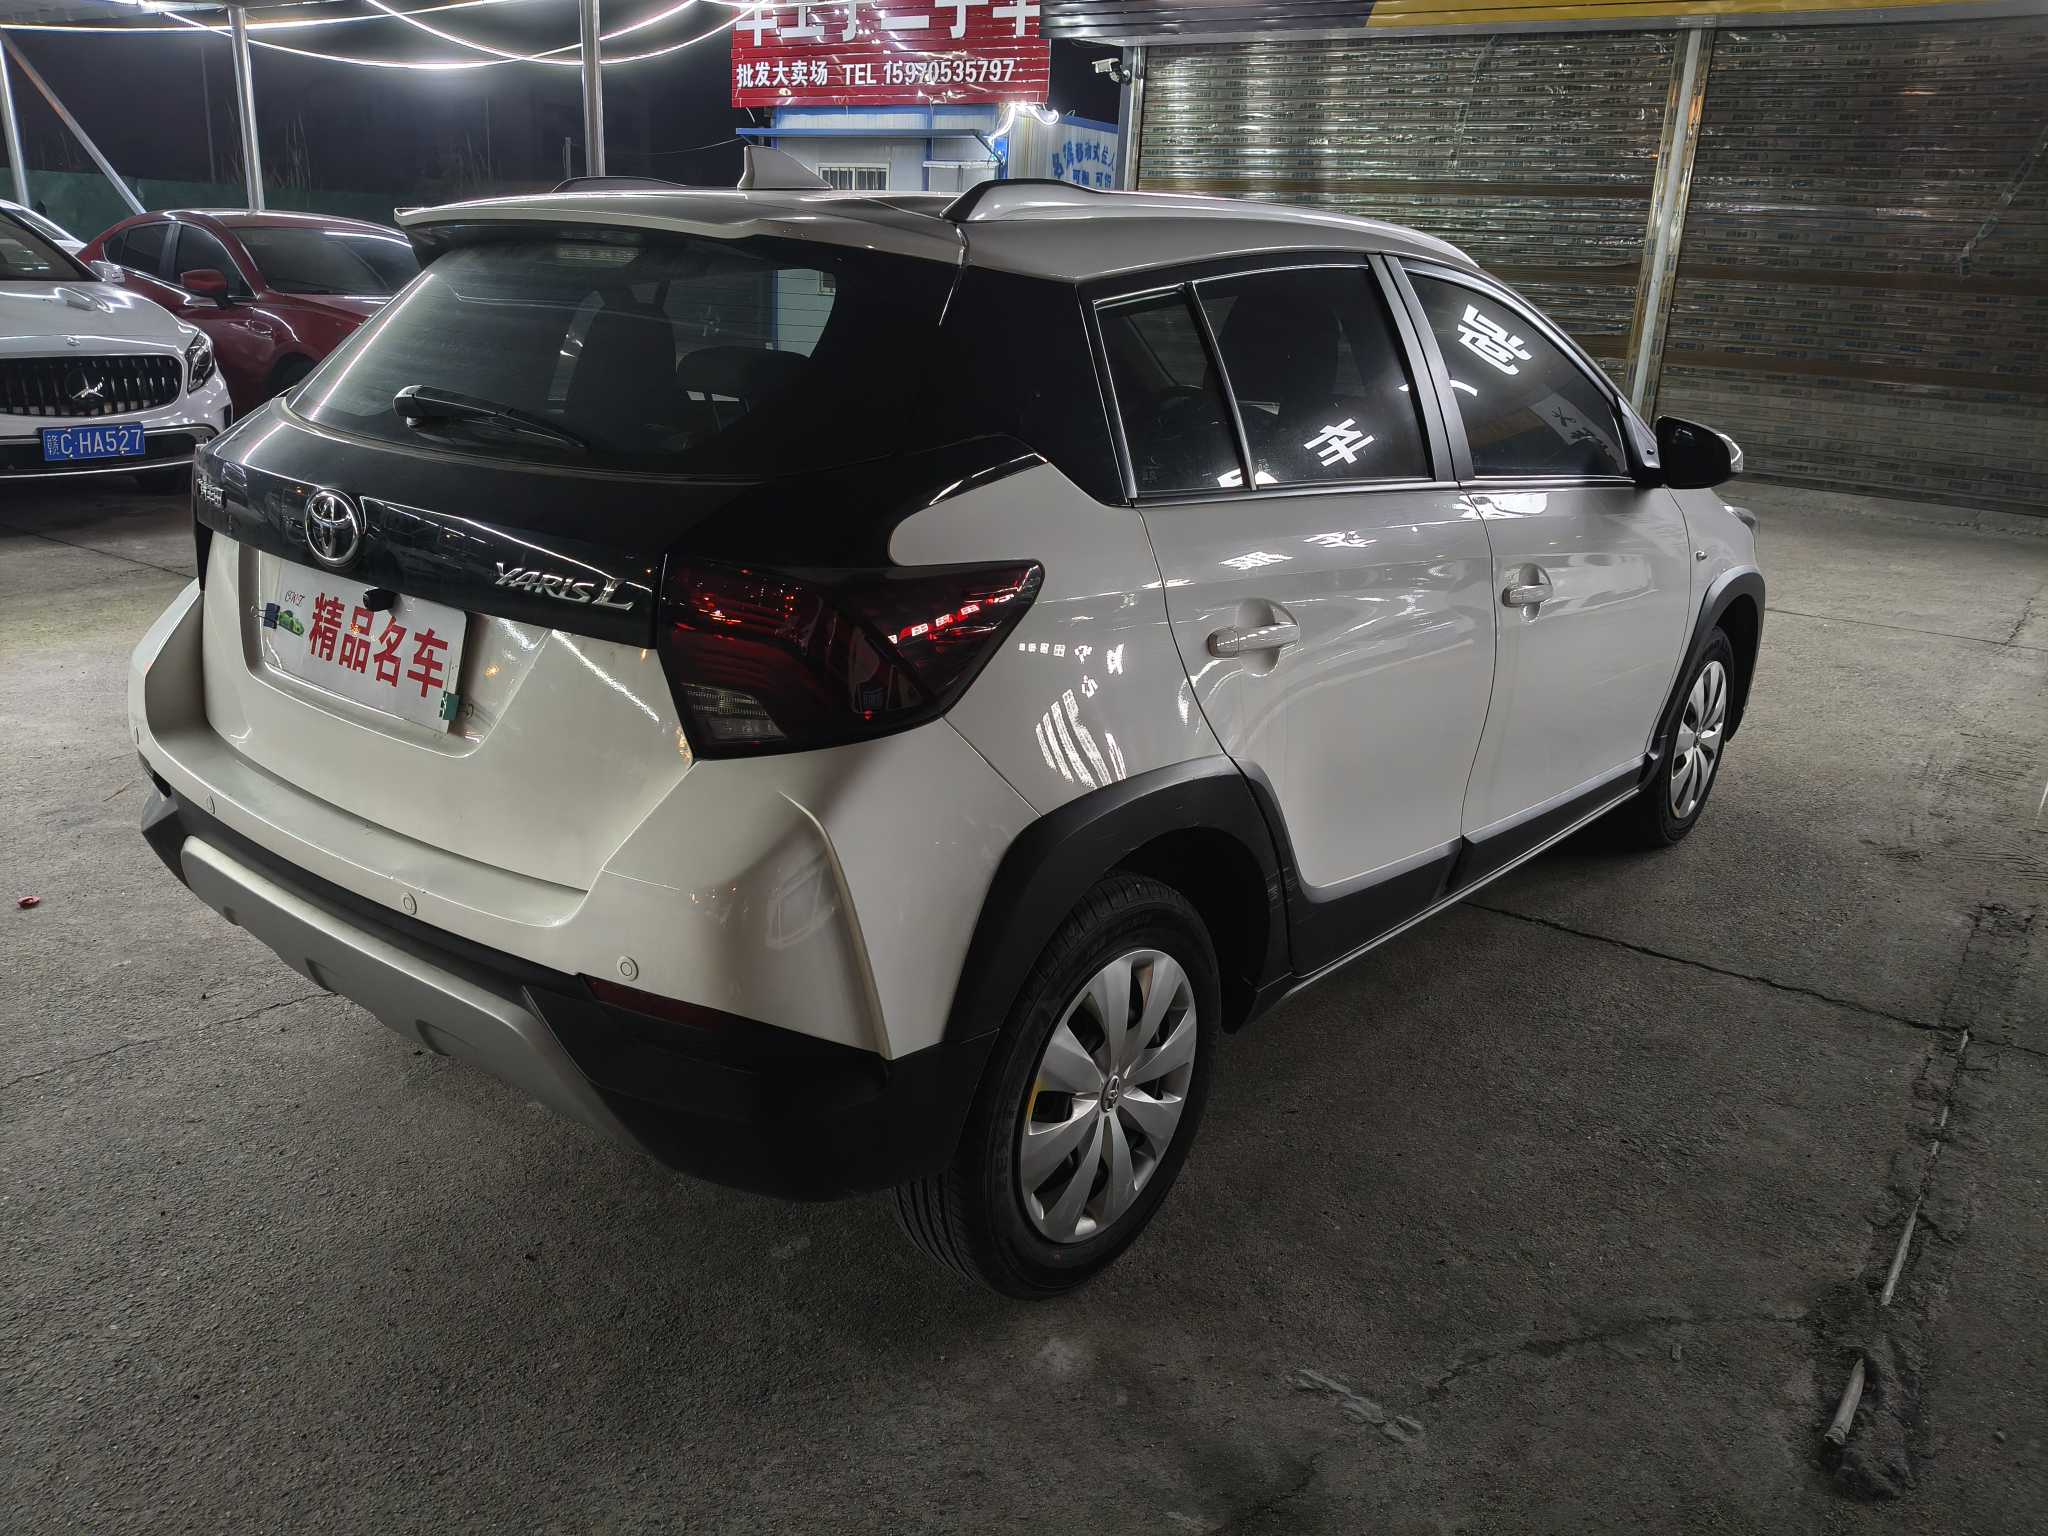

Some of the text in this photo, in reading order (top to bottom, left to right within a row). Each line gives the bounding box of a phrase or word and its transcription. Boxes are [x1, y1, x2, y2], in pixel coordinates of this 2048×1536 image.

[736, 60, 828, 87] 批发大卖场
[843, 63, 876, 85] TEL
[309, 592, 449, 698] 精品名车
